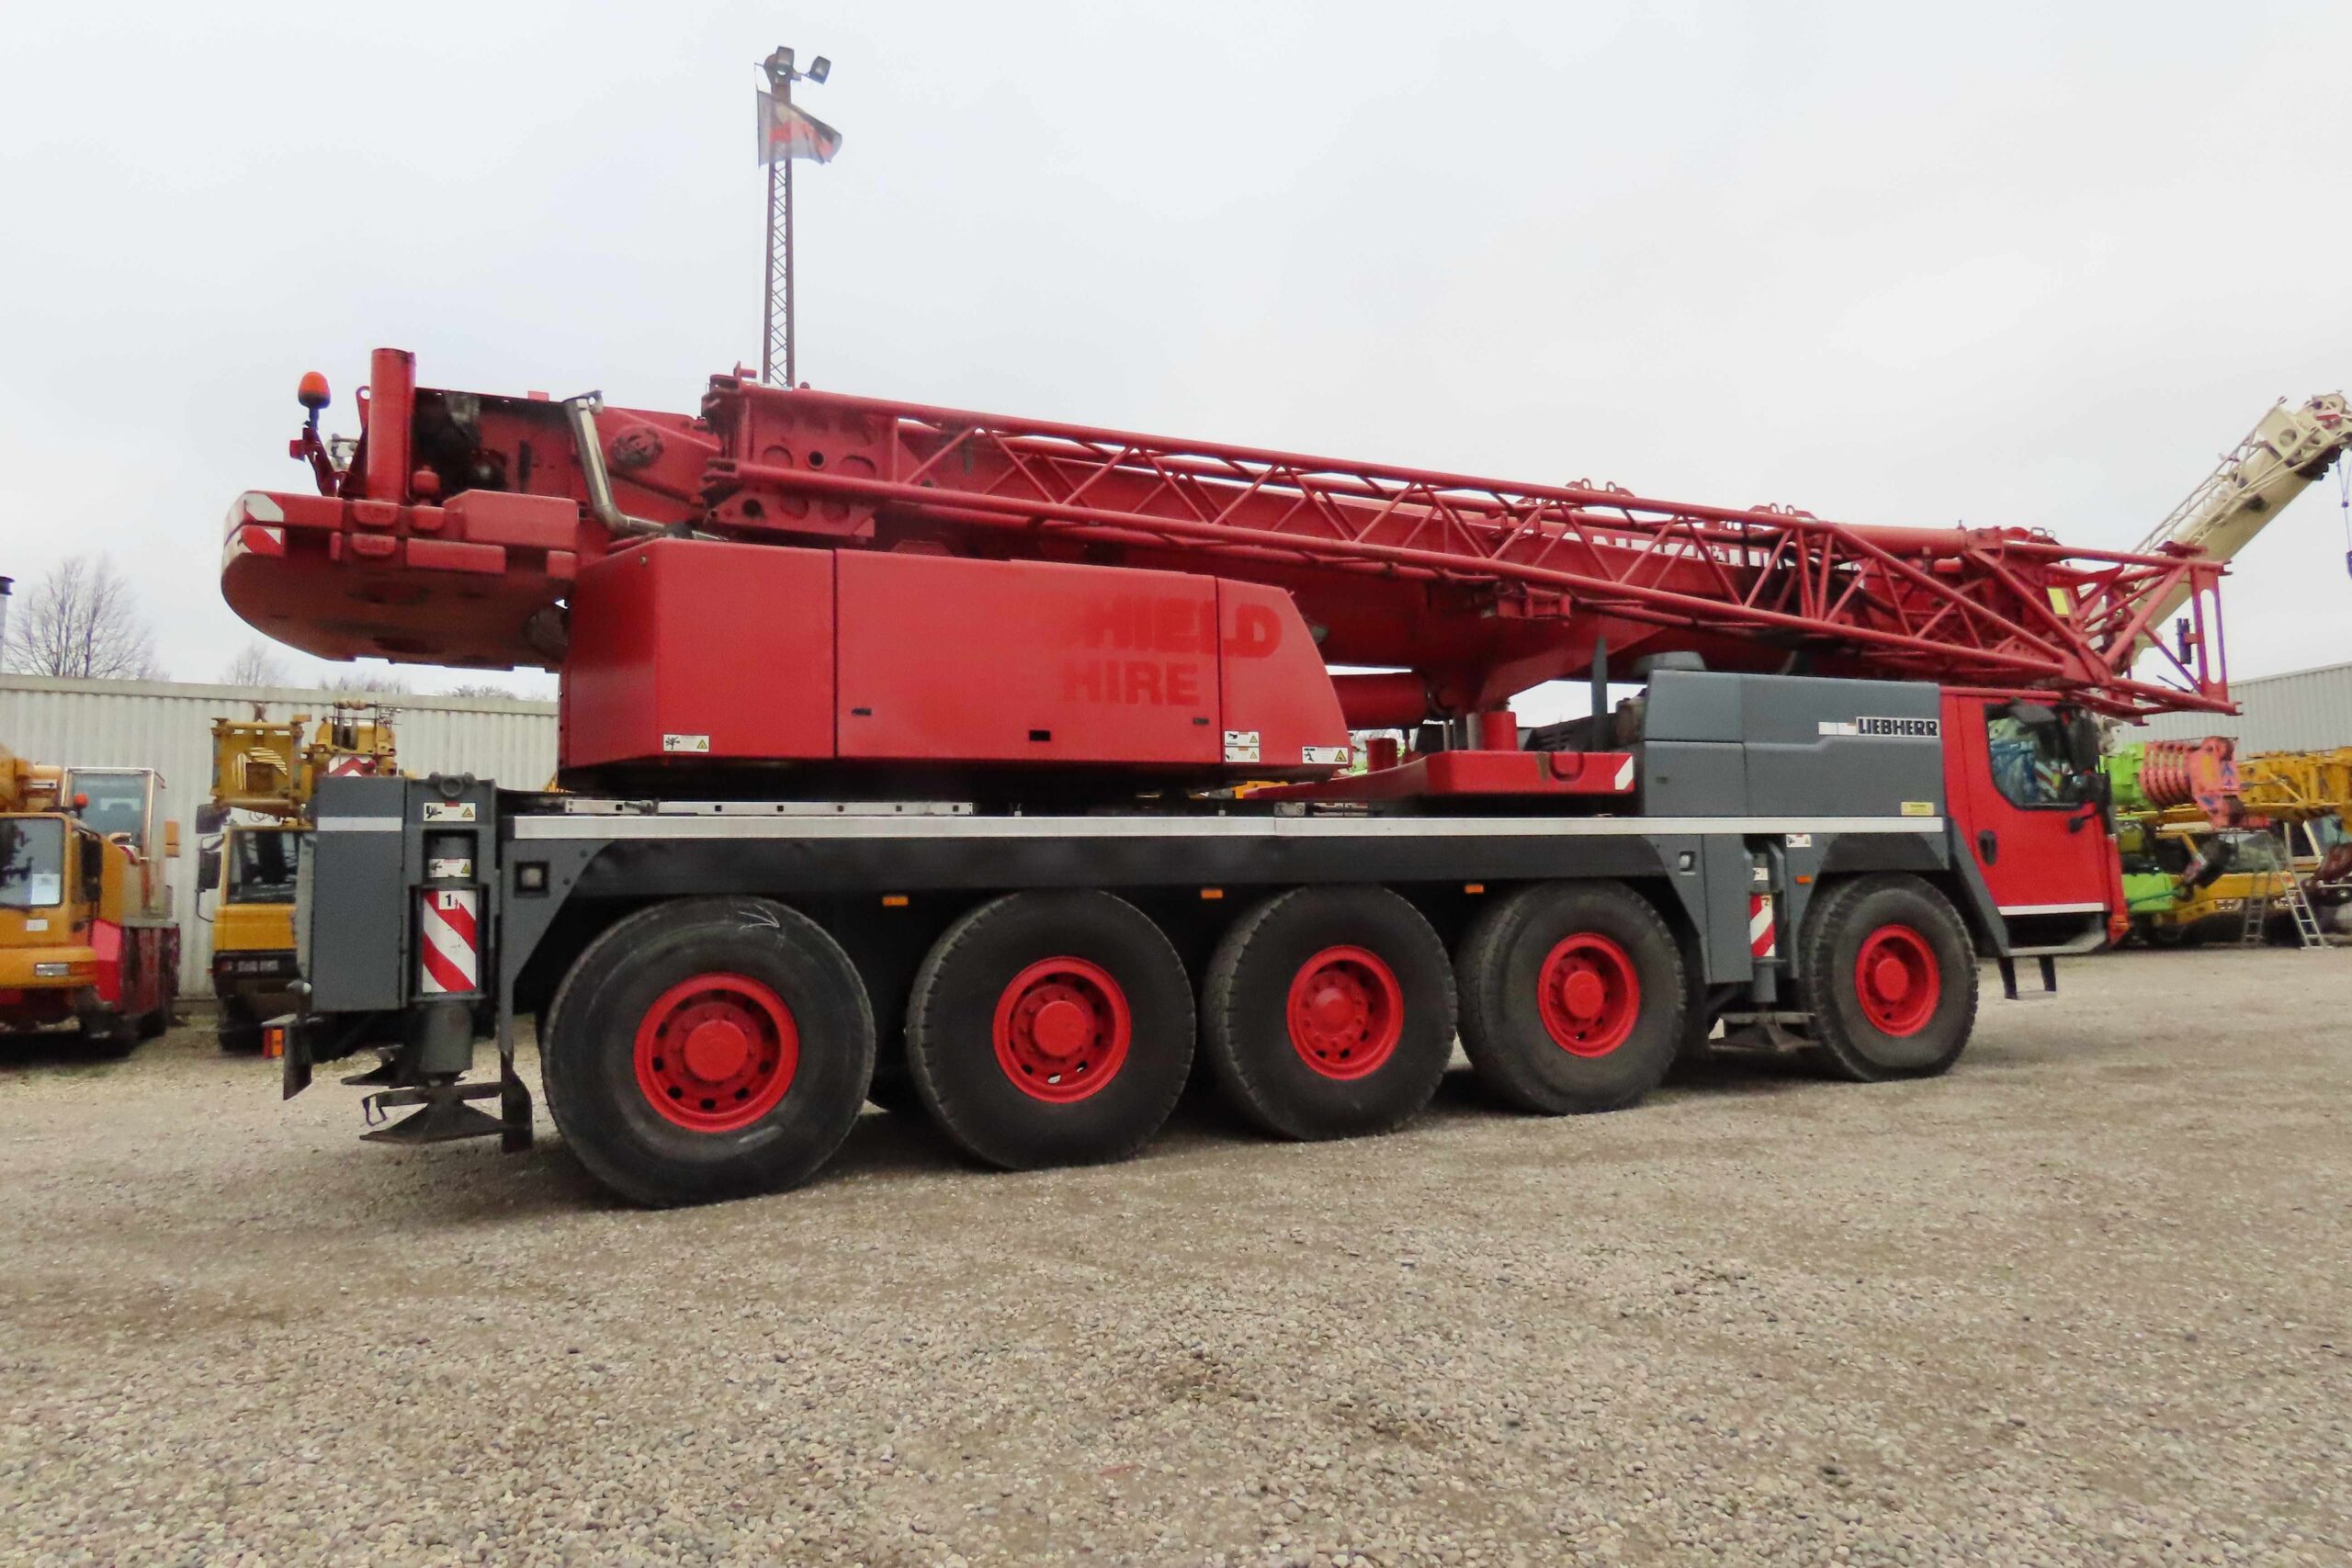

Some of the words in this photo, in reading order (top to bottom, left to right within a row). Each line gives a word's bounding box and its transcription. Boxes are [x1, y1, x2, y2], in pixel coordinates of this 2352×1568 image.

[1062, 660, 1201, 705] HIRE
[1858, 718, 1938, 737] LIEBHERR
[446, 894, 451, 906] 1
